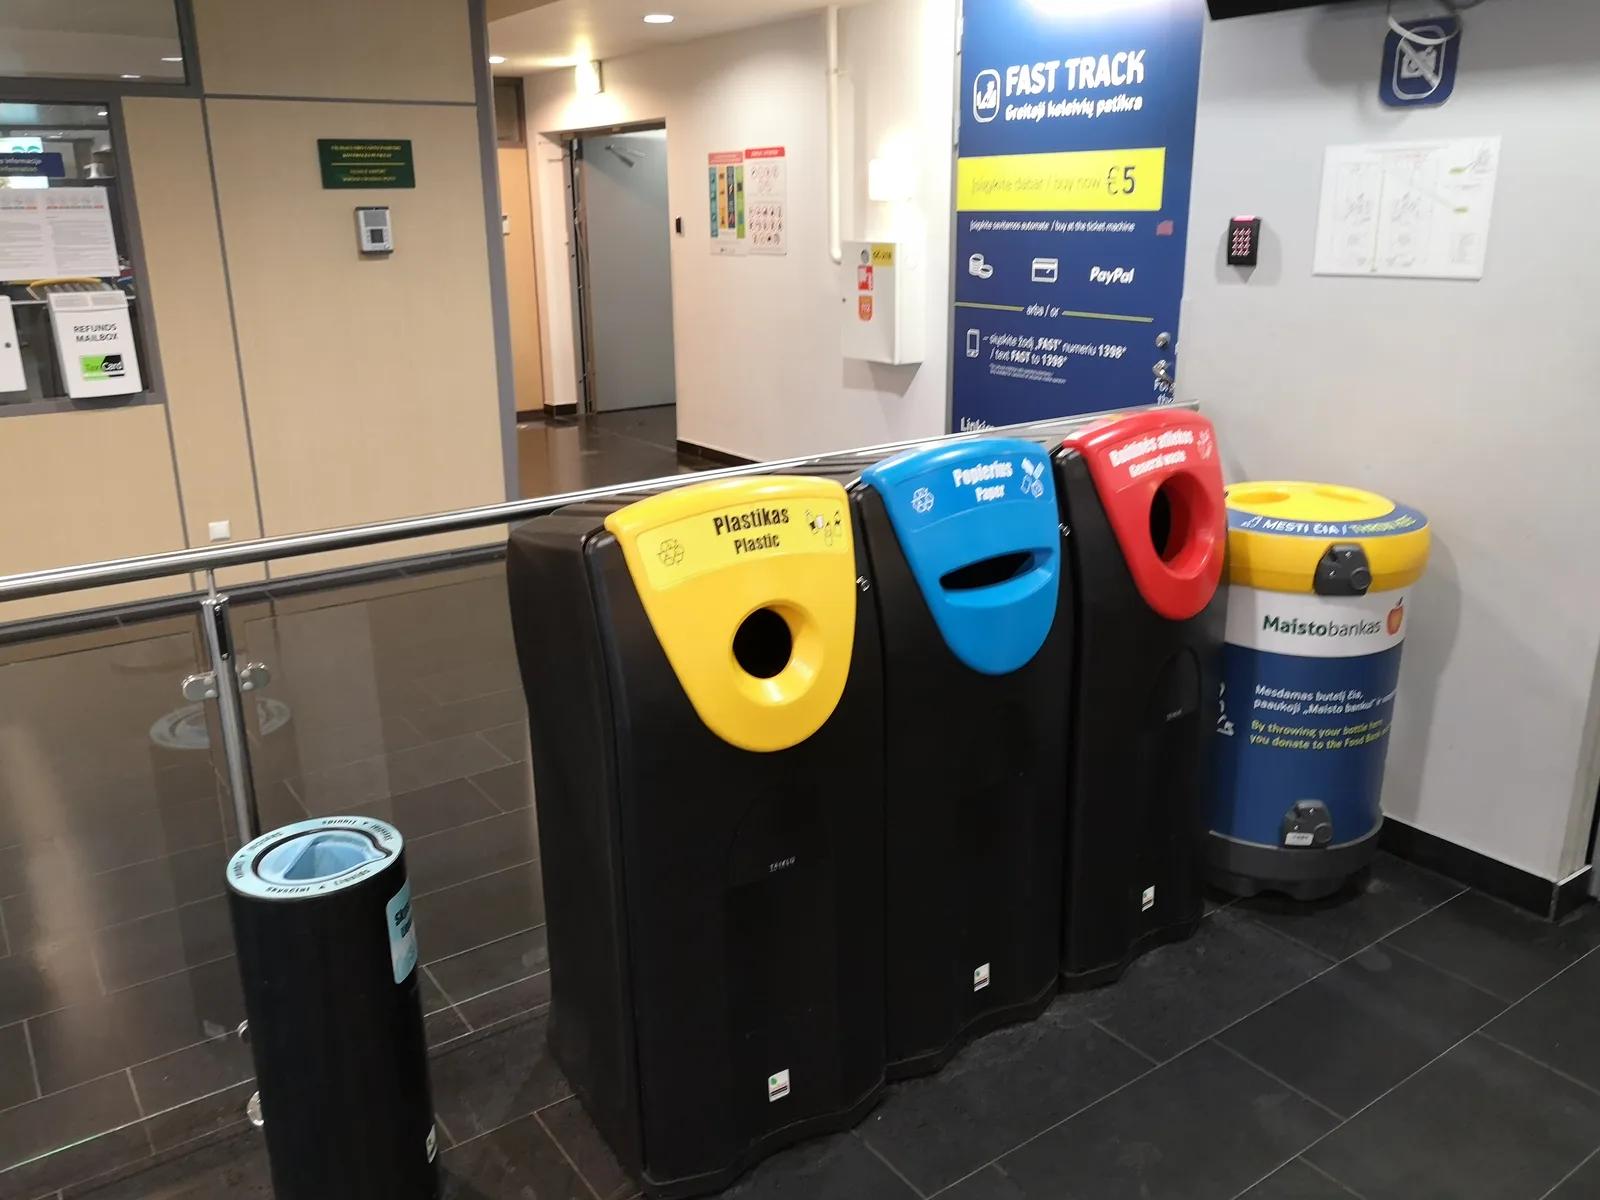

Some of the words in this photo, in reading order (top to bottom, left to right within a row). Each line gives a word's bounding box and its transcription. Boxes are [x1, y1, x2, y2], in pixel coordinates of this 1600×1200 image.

[1005, 60, 1060, 97] FAST
[1064, 49, 1146, 91] TRACK
[1107, 165, 1136, 196] €5
[1090, 266, 1135, 285] PayPal
[1010, 350, 1031, 364] FAST
[1030, 353, 1041, 366] to
[952, 460, 1013, 488] Popierius
[975, 484, 1005, 502] Paper
[713, 505, 790, 536] Plastikas
[1262, 519, 1309, 534] MESTI
[734, 533, 780, 555] Plastic
[1263, 614, 1381, 638] Maistobankas
[1255, 684, 1314, 701] Mesdamas
[1251, 719, 1266, 733] By
[1267, 723, 1318, 739] throwing
[1318, 727, 1342, 739] your
[1249, 734, 1270, 745] you
[1271, 737, 1311, 750] donate
[1312, 740, 1325, 750] to
[1325, 739, 1344, 750] the
[1343, 735, 1366, 748] Food
